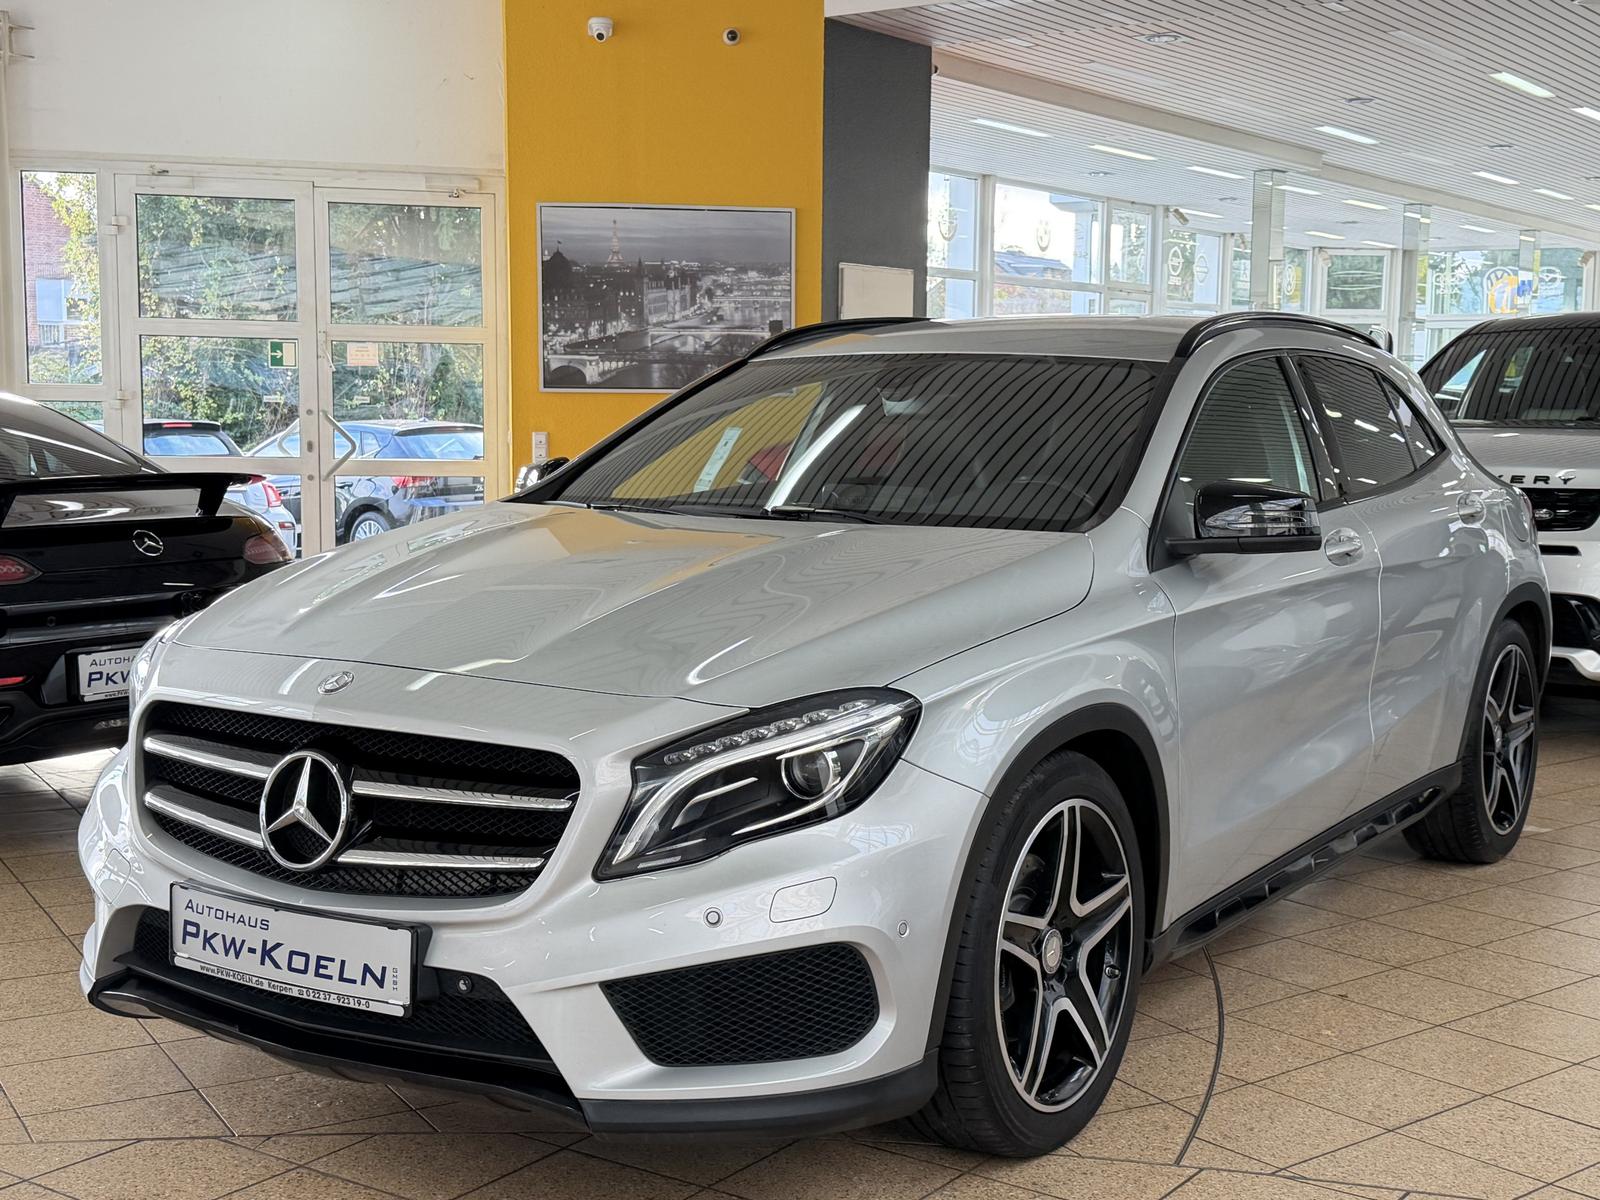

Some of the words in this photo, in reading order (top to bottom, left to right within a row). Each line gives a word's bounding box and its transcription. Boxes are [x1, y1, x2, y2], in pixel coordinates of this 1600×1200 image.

[184, 898, 270, 931] AUTOHAUS
[181, 918, 388, 990] PKW-KOELN
[199, 964, 264, 987] www.PKW-KOELN.de
[267, 980, 294, 994] Kerpen
